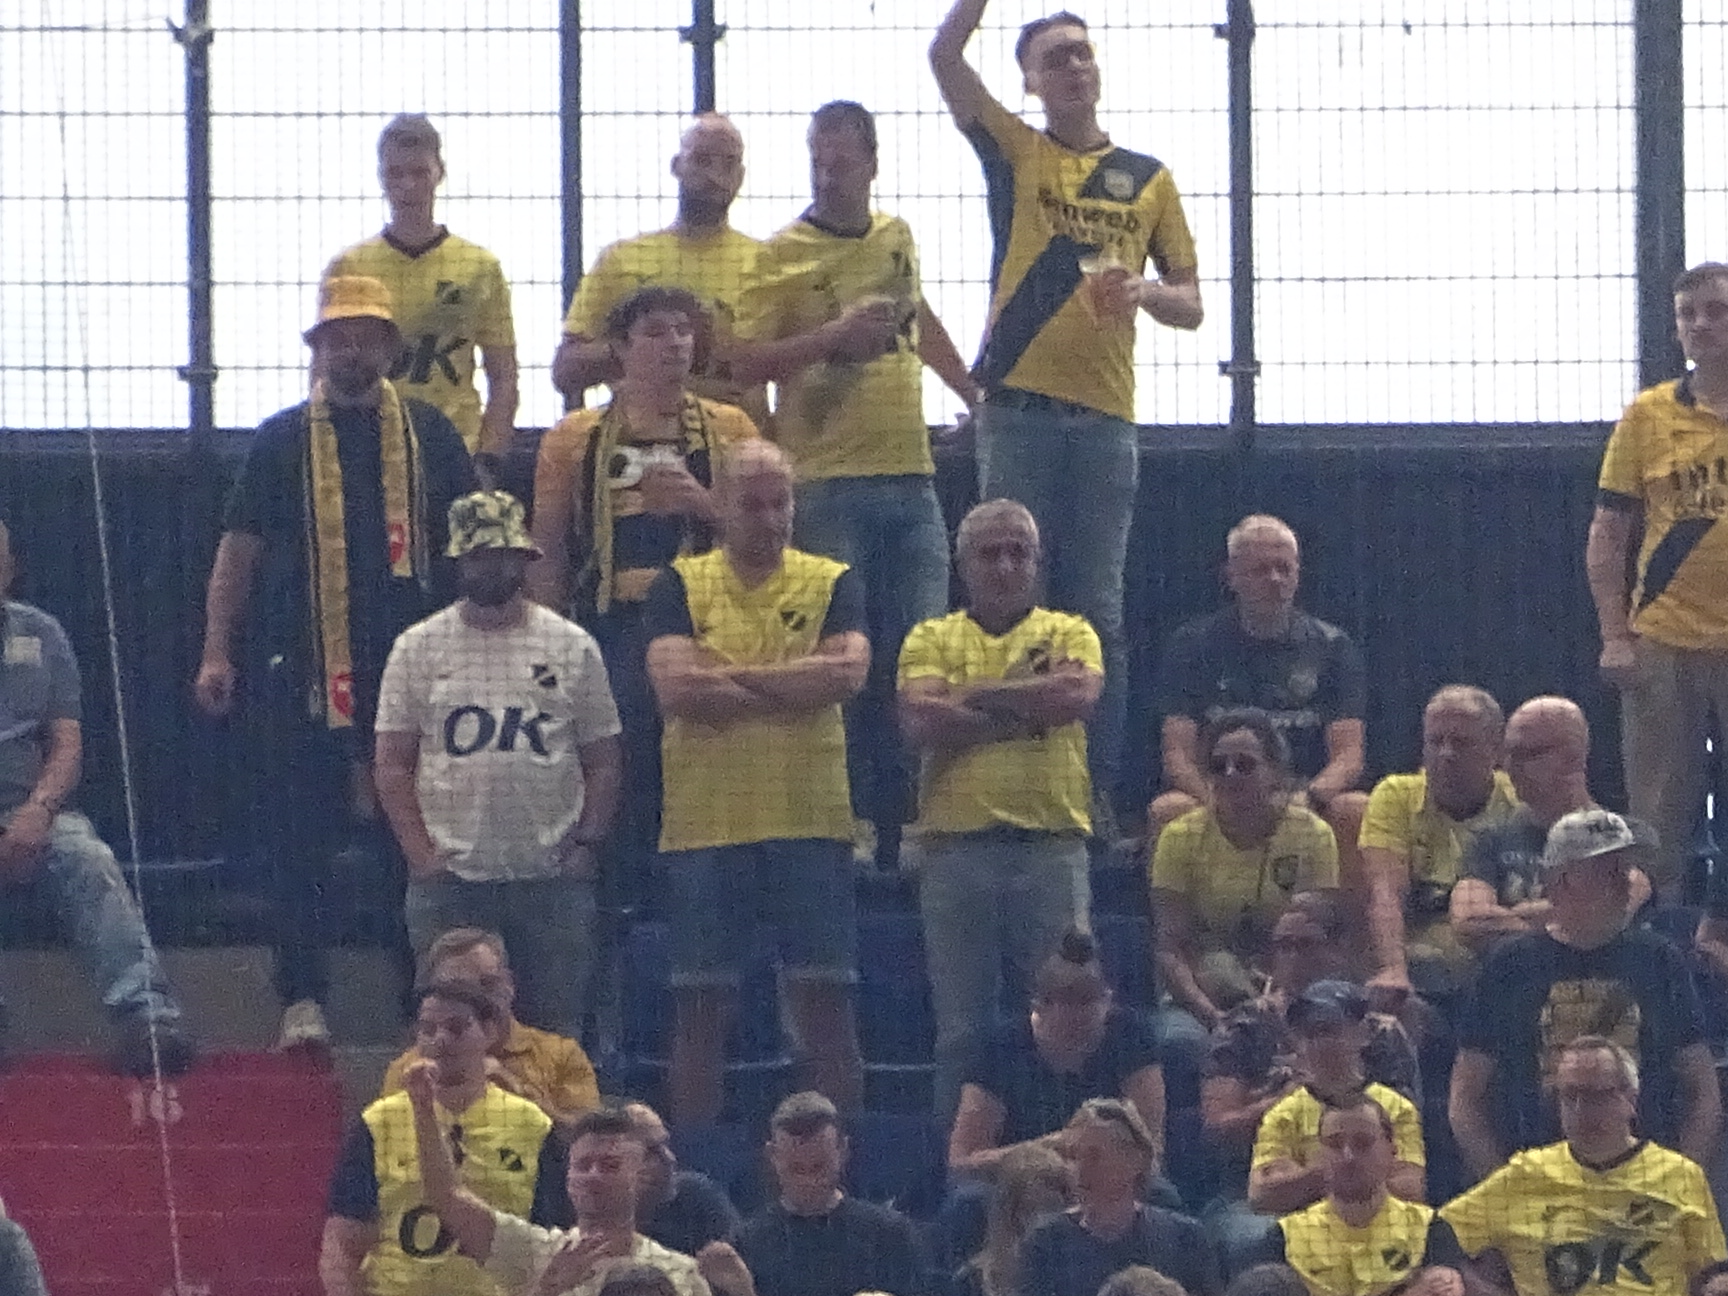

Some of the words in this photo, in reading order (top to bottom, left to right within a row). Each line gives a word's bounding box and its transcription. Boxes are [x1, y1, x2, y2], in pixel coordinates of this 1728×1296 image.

[442, 705, 551, 757] OK
[400, 1205, 452, 1259] O
[1544, 1239, 1662, 1295] OK
